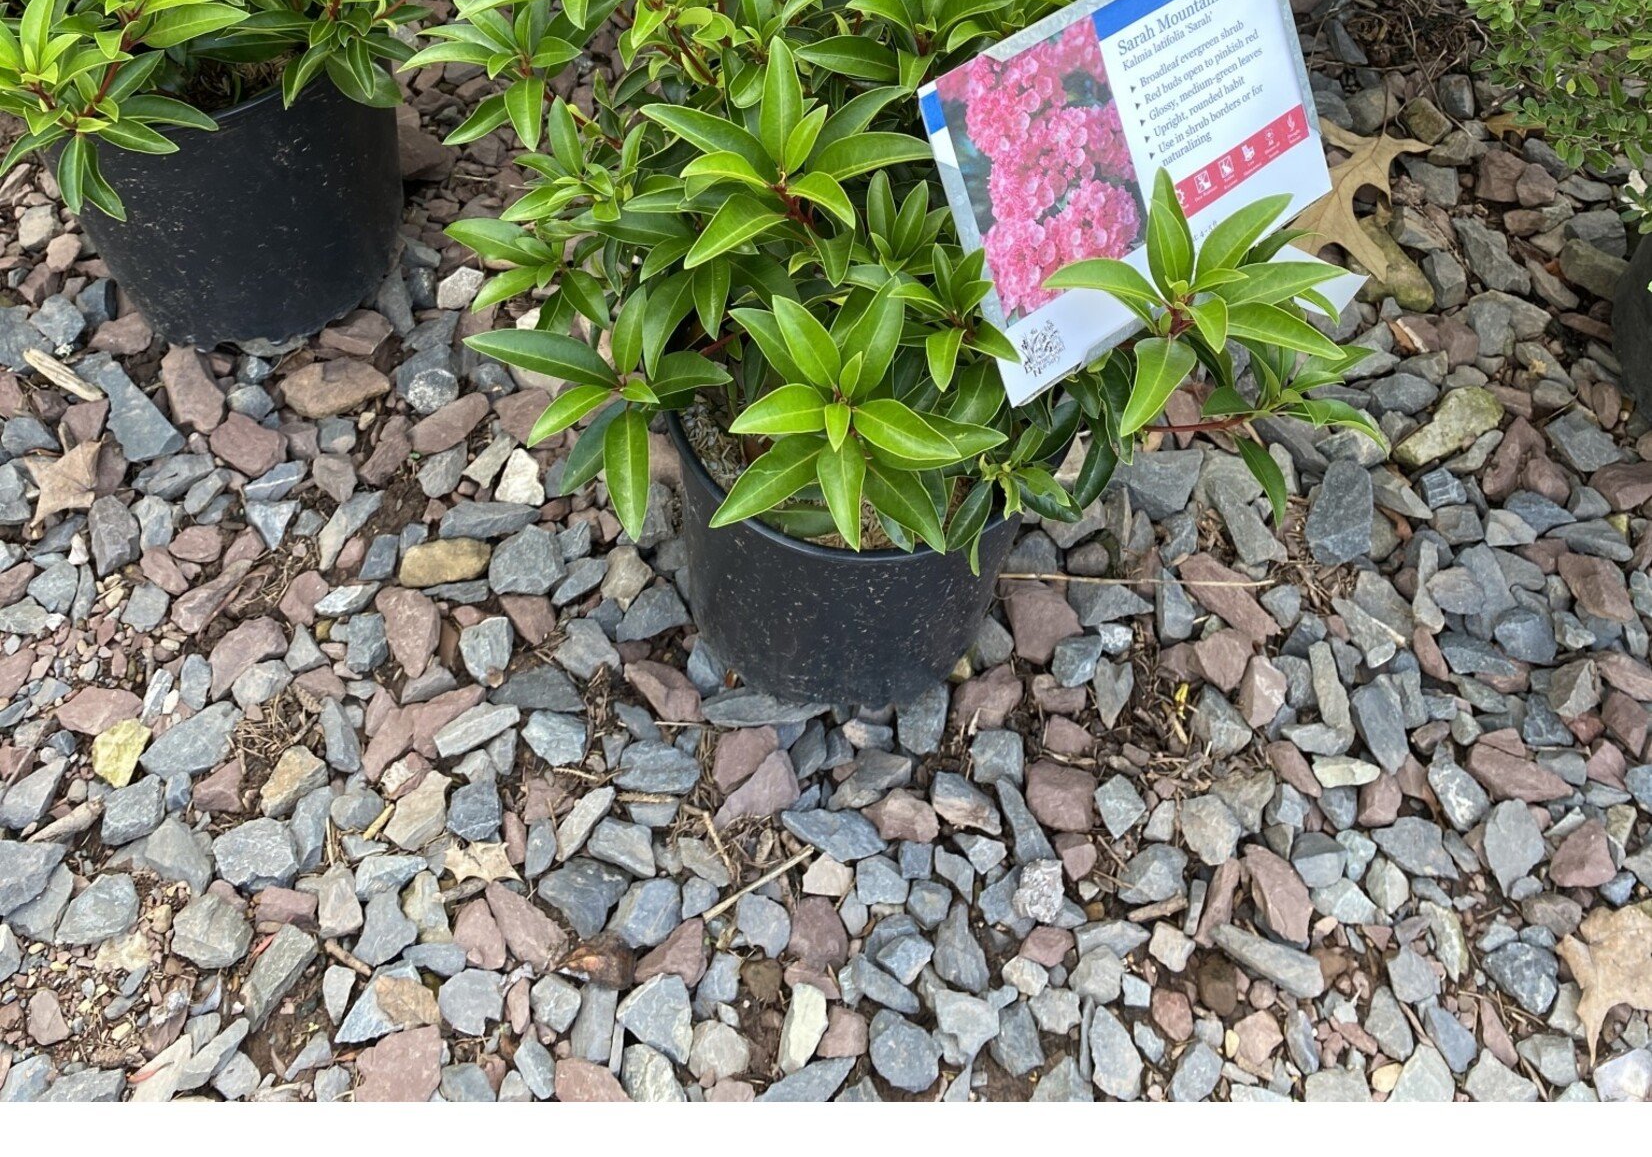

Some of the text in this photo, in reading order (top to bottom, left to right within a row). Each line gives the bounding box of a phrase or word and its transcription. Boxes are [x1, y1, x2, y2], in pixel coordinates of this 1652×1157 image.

[1117, 24, 1156, 56] Sarah
[1122, 48, 1153, 71] Kalmia
[1152, 29, 1185, 54] latifolia
[1139, 20, 1244, 87] Broadleaf evergreen shrub
[1144, 29, 1259, 104] Red buds open to pinkish red
[1149, 47, 1263, 121] Glossy, medium-green leaves
[1153, 75, 1245, 137] Upright, rounded habit
[1158, 83, 1264, 154] Use in shrub borders or for
[1162, 131, 1213, 167] naturalizing
